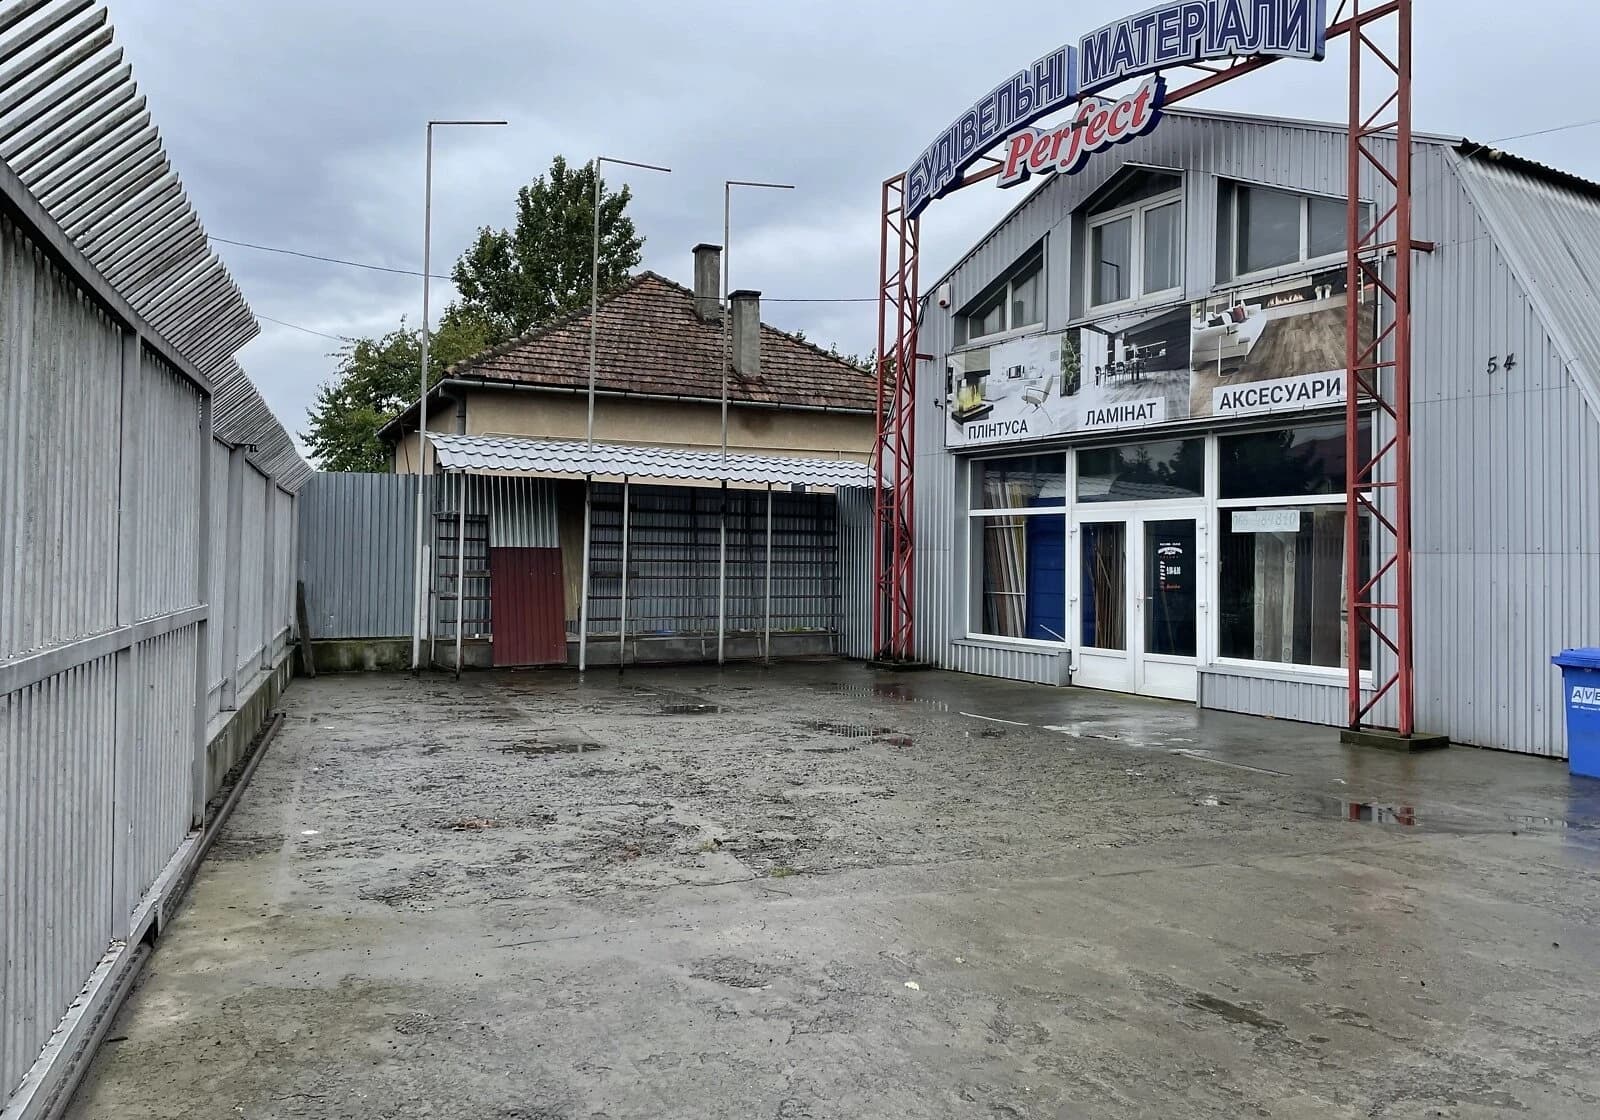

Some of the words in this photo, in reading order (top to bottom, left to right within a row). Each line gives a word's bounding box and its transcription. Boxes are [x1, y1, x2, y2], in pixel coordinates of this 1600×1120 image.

[905, 48, 1067, 213] БУДІВЕЛЬНІ
[1081, 0, 1310, 87] МАТЕРІАЛИ
[1002, 84, 1150, 179] Perfect
[1487, 352, 1516, 375] 54
[1219, 377, 1341, 410] АКСЕСУАРИ
[1085, 402, 1157, 426] ЛАМІНАТ
[968, 419, 1029, 440] ПЛІНТУСА
